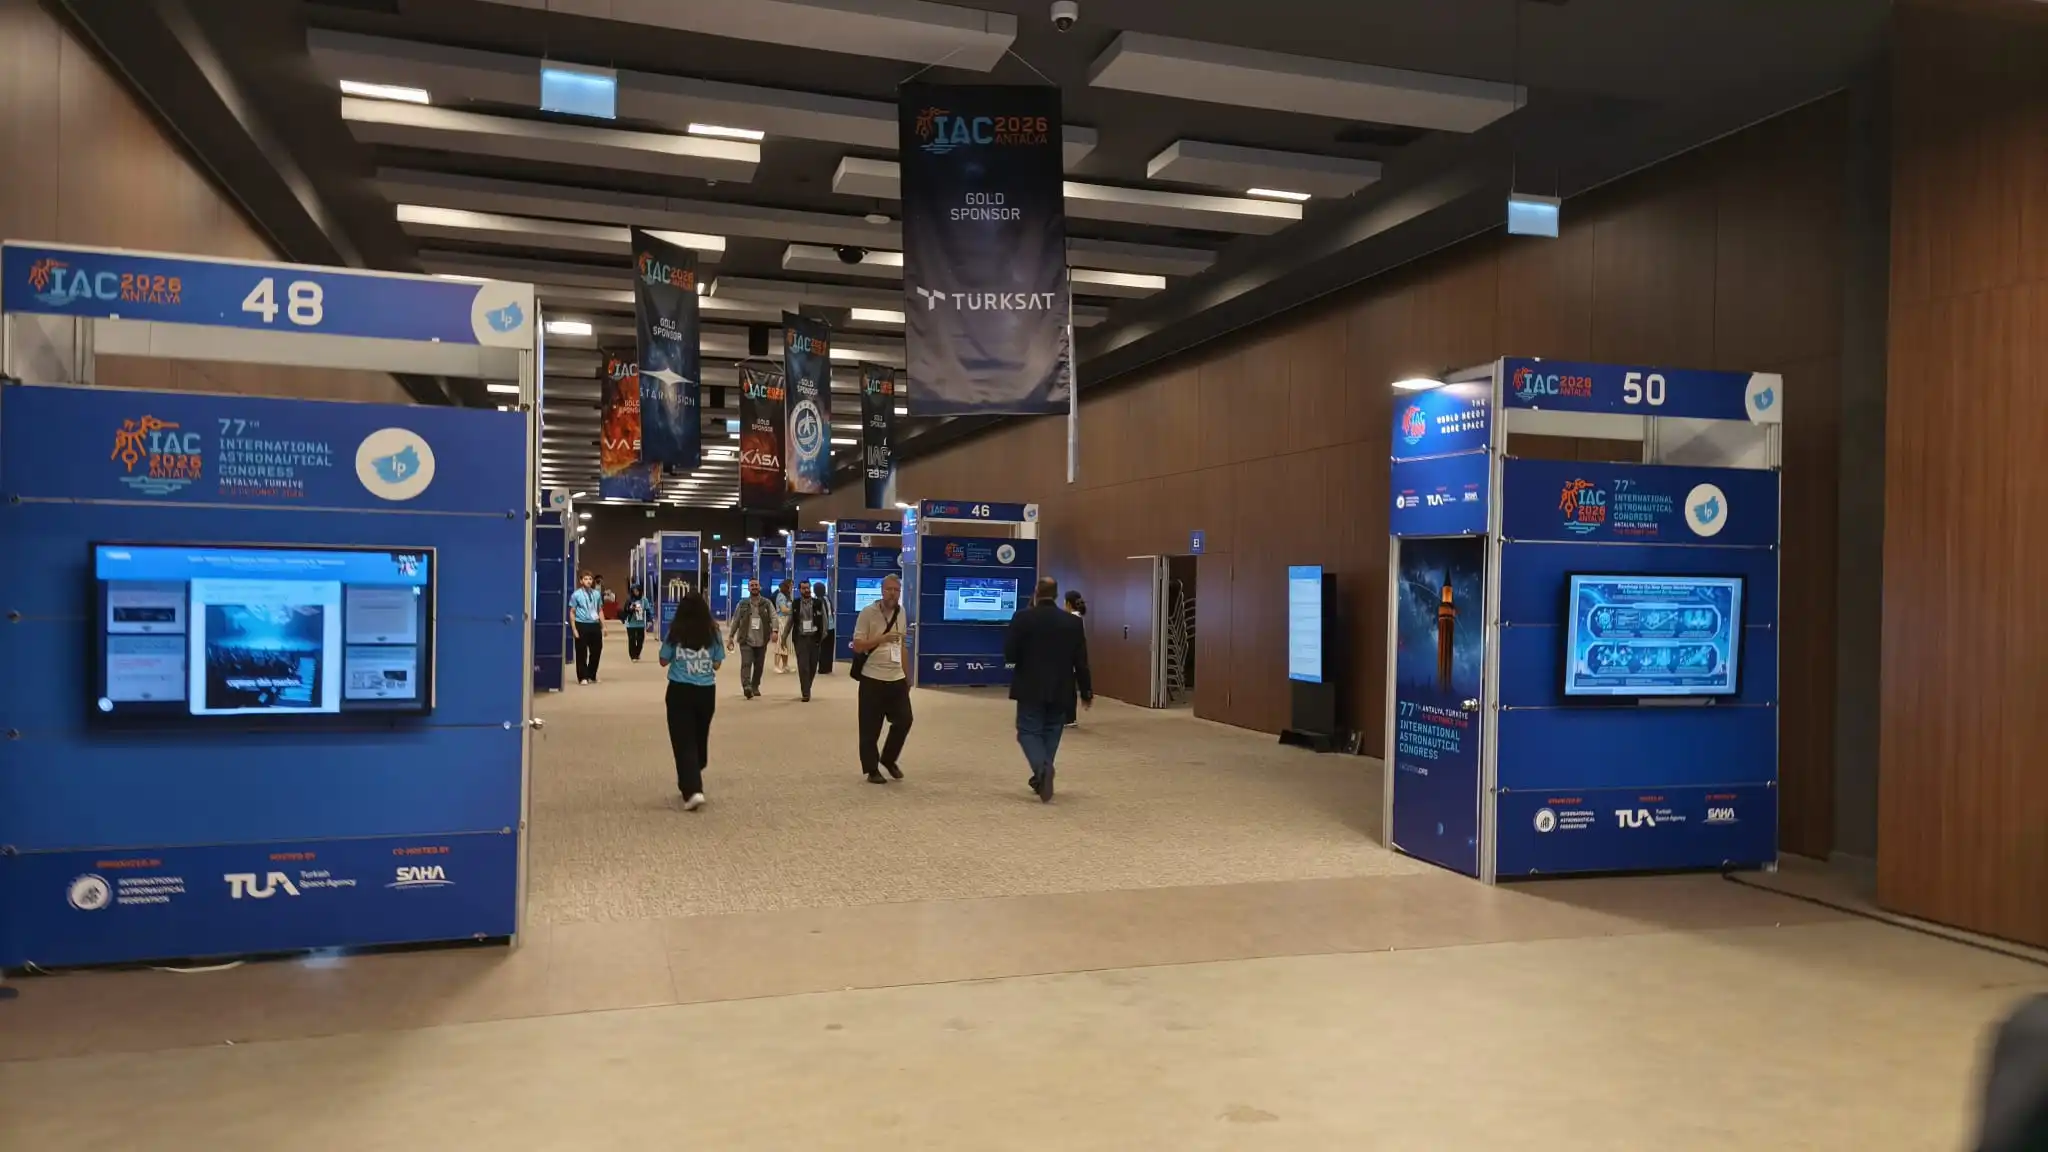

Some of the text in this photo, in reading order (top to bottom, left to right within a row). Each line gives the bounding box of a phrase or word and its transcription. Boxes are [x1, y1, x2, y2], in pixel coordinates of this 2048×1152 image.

[934, 116, 993, 144] IAC
[994, 116, 1047, 131] 2026
[995, 132, 1047, 144] ANTALYA
[965, 192, 1005, 205] GOLD
[950, 208, 1020, 220] SPONSOR
[645, 259, 671, 284] IAC
[51, 268, 323, 325] IAC 48
[121, 290, 181, 304] ANTALYA
[660, 317, 676, 330] GOLD
[652, 326, 683, 341] SPONSOR
[614, 363, 638, 377] IAC
[1523, 372, 1665, 405] IAC 50
[150, 432, 201, 454] IAC
[219, 438, 333, 454] INTERNATIONAL
[219, 451, 333, 467] ASTRONAUTICAL
[219, 464, 293, 478] CONGRESS
[1579, 490, 1606, 505] IAC
[1614, 493, 1673, 504] INTERNATIONAL
[971, 504, 990, 517] 46
[1613, 503, 1673, 513] ASTRONAUTICAL
[1613, 512, 1654, 521] CONGRESS
[876, 522, 891, 532] 42
[1400, 720, 1460, 740] INTERNATIONAL
[1400, 731, 1460, 753] ASTRONAUTICAL
[1400, 742, 1439, 759] CONGRESS
[1615, 808, 1656, 828] TUA
[396, 865, 445, 881] SAHA
[224, 871, 300, 899] TUA
